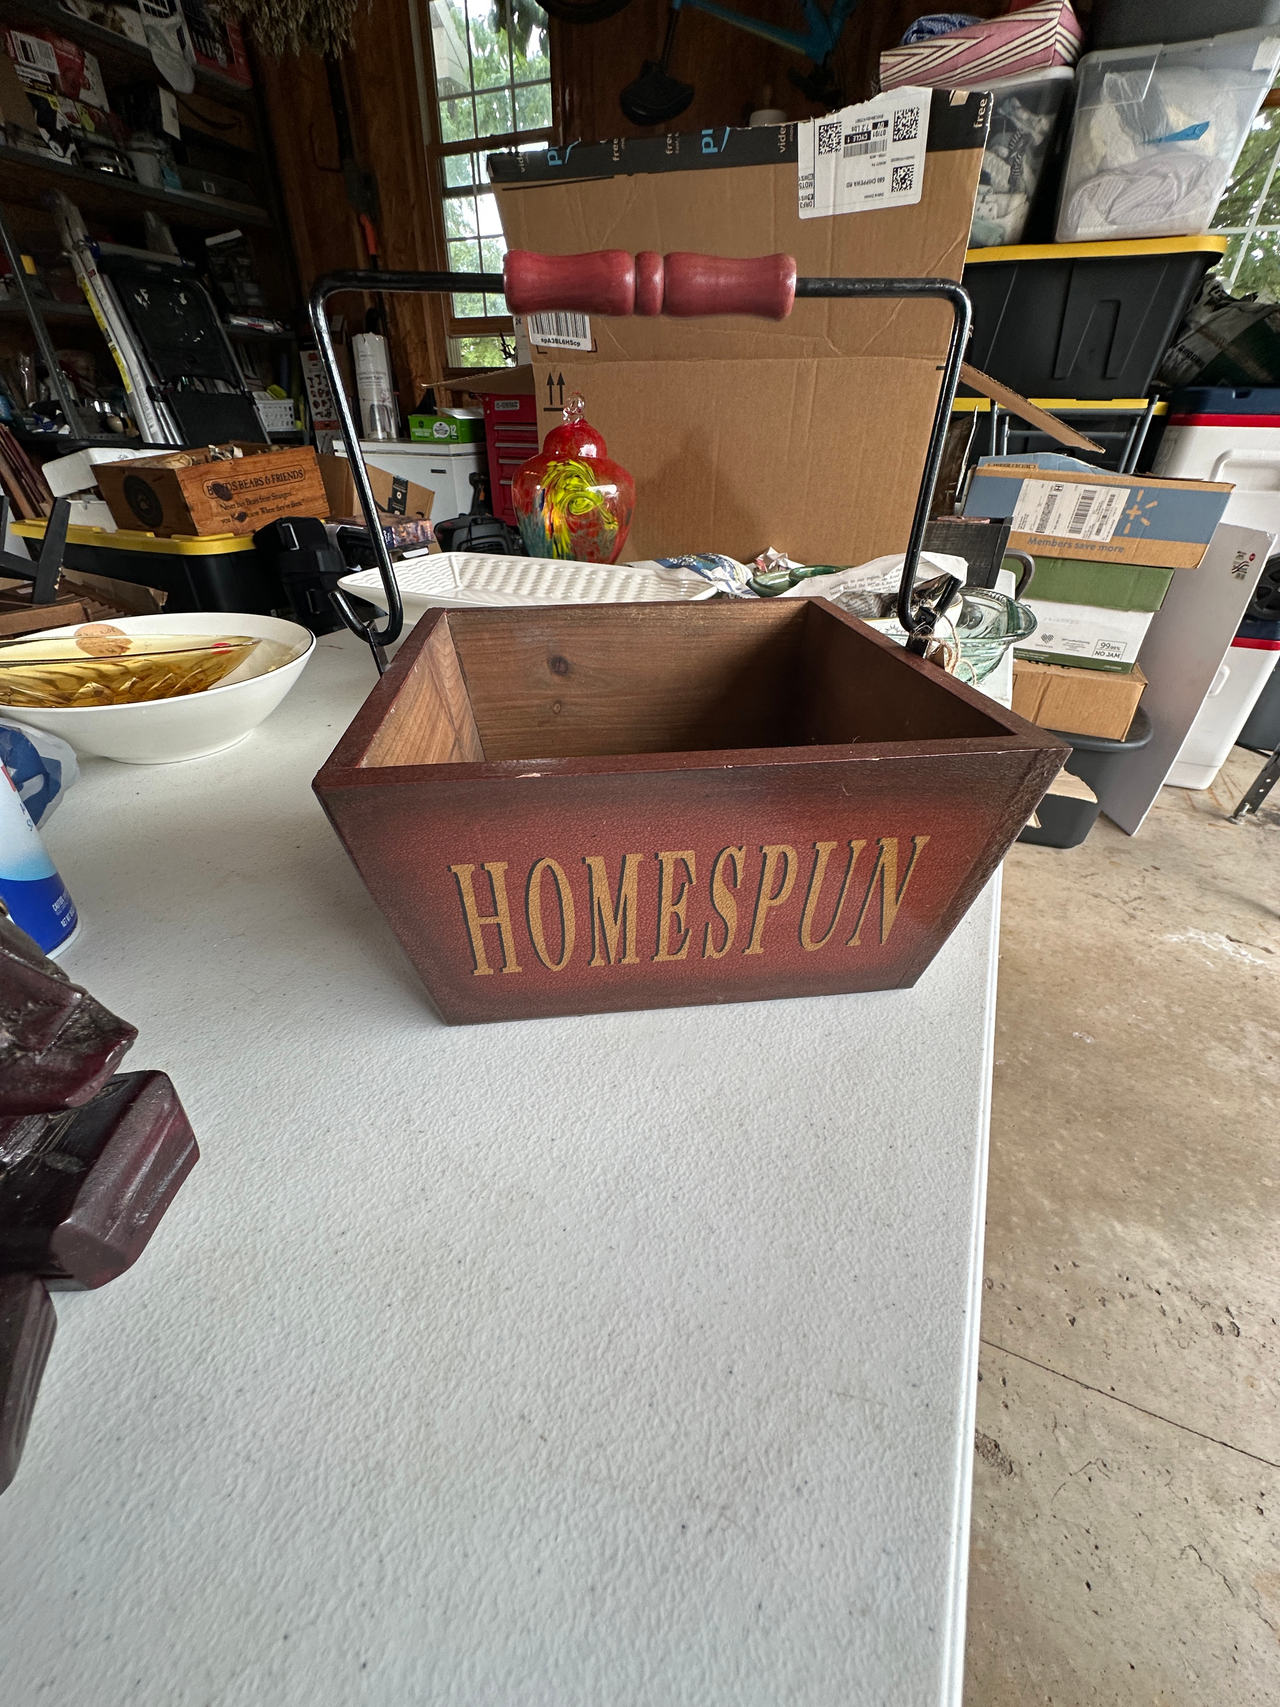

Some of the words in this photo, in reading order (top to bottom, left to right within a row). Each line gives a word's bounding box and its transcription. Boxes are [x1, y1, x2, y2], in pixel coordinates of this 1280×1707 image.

[973, 98, 987, 128] free
[776, 124, 788, 153] vide
[853, 133, 868, 142] CYCLE
[238, 478, 265, 491] BEARS
[271, 469, 304, 483] FRIENDS
[1027, 536, 1073, 549] Members
[1074, 542, 1097, 551] save
[1097, 545, 1125, 553] more
[448, 835, 931, 977] HOMESPUN
